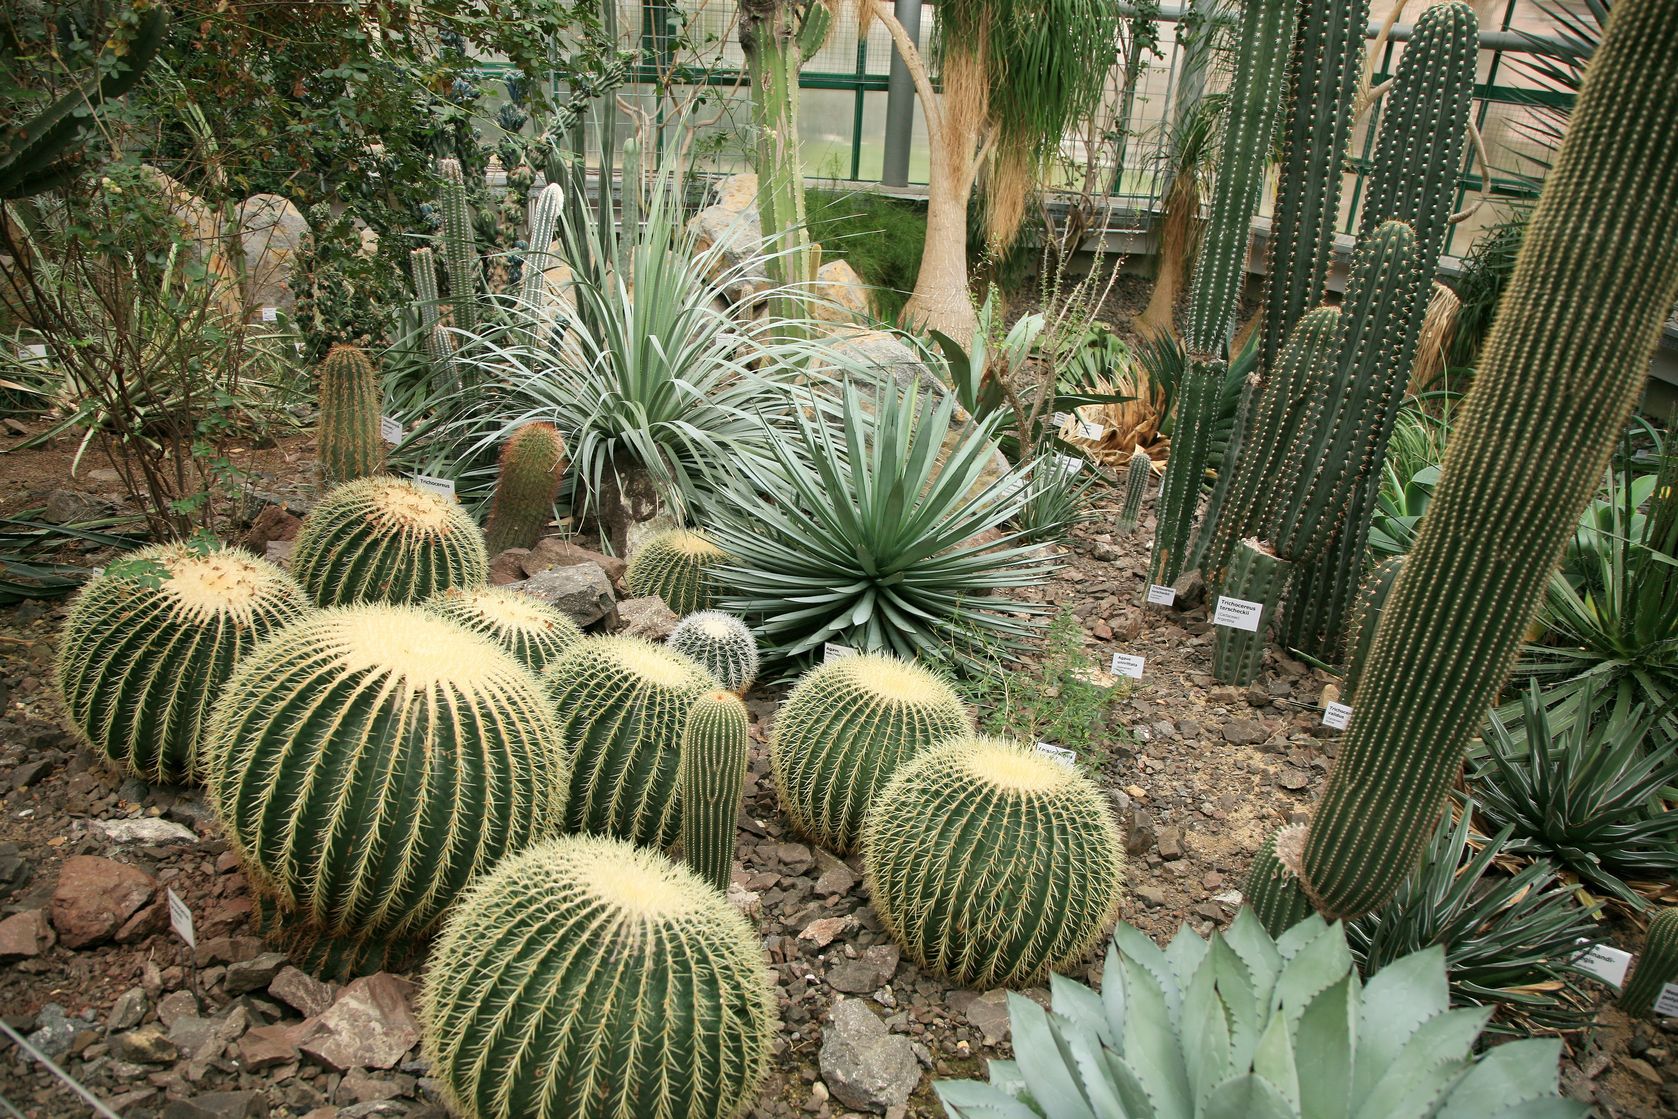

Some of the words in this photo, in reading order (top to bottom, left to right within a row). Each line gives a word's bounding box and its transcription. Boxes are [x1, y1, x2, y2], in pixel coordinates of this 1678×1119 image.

[1219, 605, 1250, 616] terscheckii
[1221, 599, 1256, 611] Trichocereus
[1329, 705, 1351, 715] Trichocer
